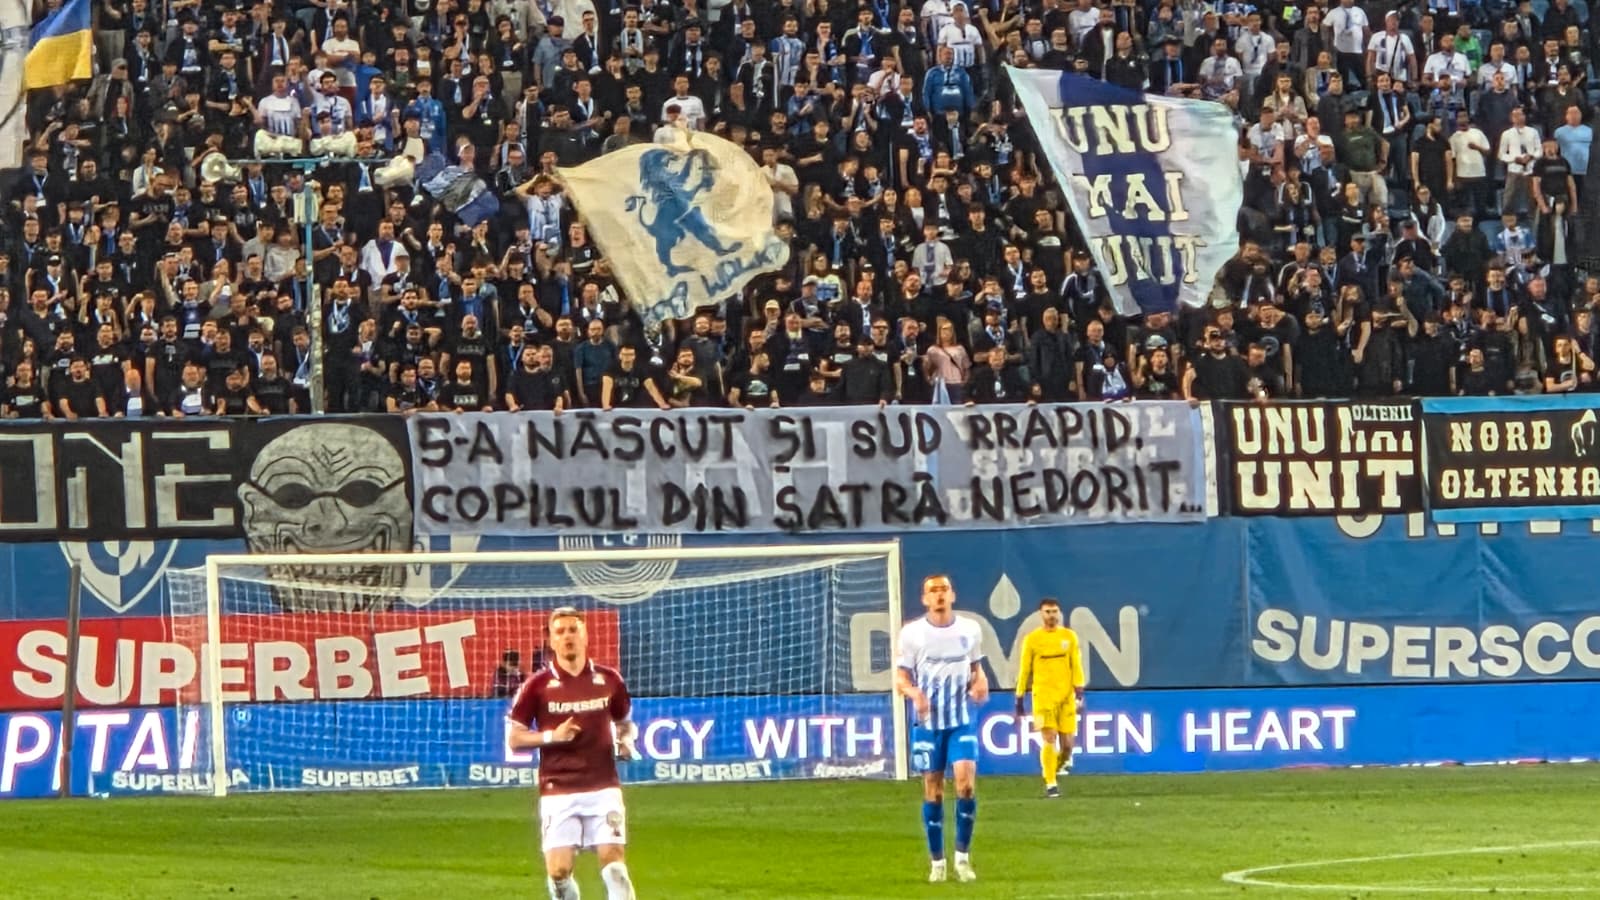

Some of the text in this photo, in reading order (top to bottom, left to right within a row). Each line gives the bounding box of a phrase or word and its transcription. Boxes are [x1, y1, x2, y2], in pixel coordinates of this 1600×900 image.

[1050, 103, 1172, 155] UNU
[1072, 171, 1190, 221] MAI
[1091, 235, 1208, 286] UNIT
[417, 416, 504, 468] S-A
[967, 405, 1144, 452] RRAPID.
[1232, 406, 1325, 455] UNU
[1351, 404, 1414, 421] OLTENII
[1450, 420, 1553, 452] NORD
[421, 482, 638, 528] COPILUL
[661, 480, 747, 531] DIN
[1236, 459, 1415, 509] UNIT
[1440, 466, 1600, 499] OLTENIA
[12, 618, 478, 706] SUPERBET
[1251, 608, 1600, 678] SUPERSCO
[744, 716, 883, 760] WITH
[1185, 708, 1356, 752] HEART
[112, 767, 250, 791] SUPERLIA
[302, 765, 420, 788] SUPERBET
[654, 759, 773, 782] SUPERBET
